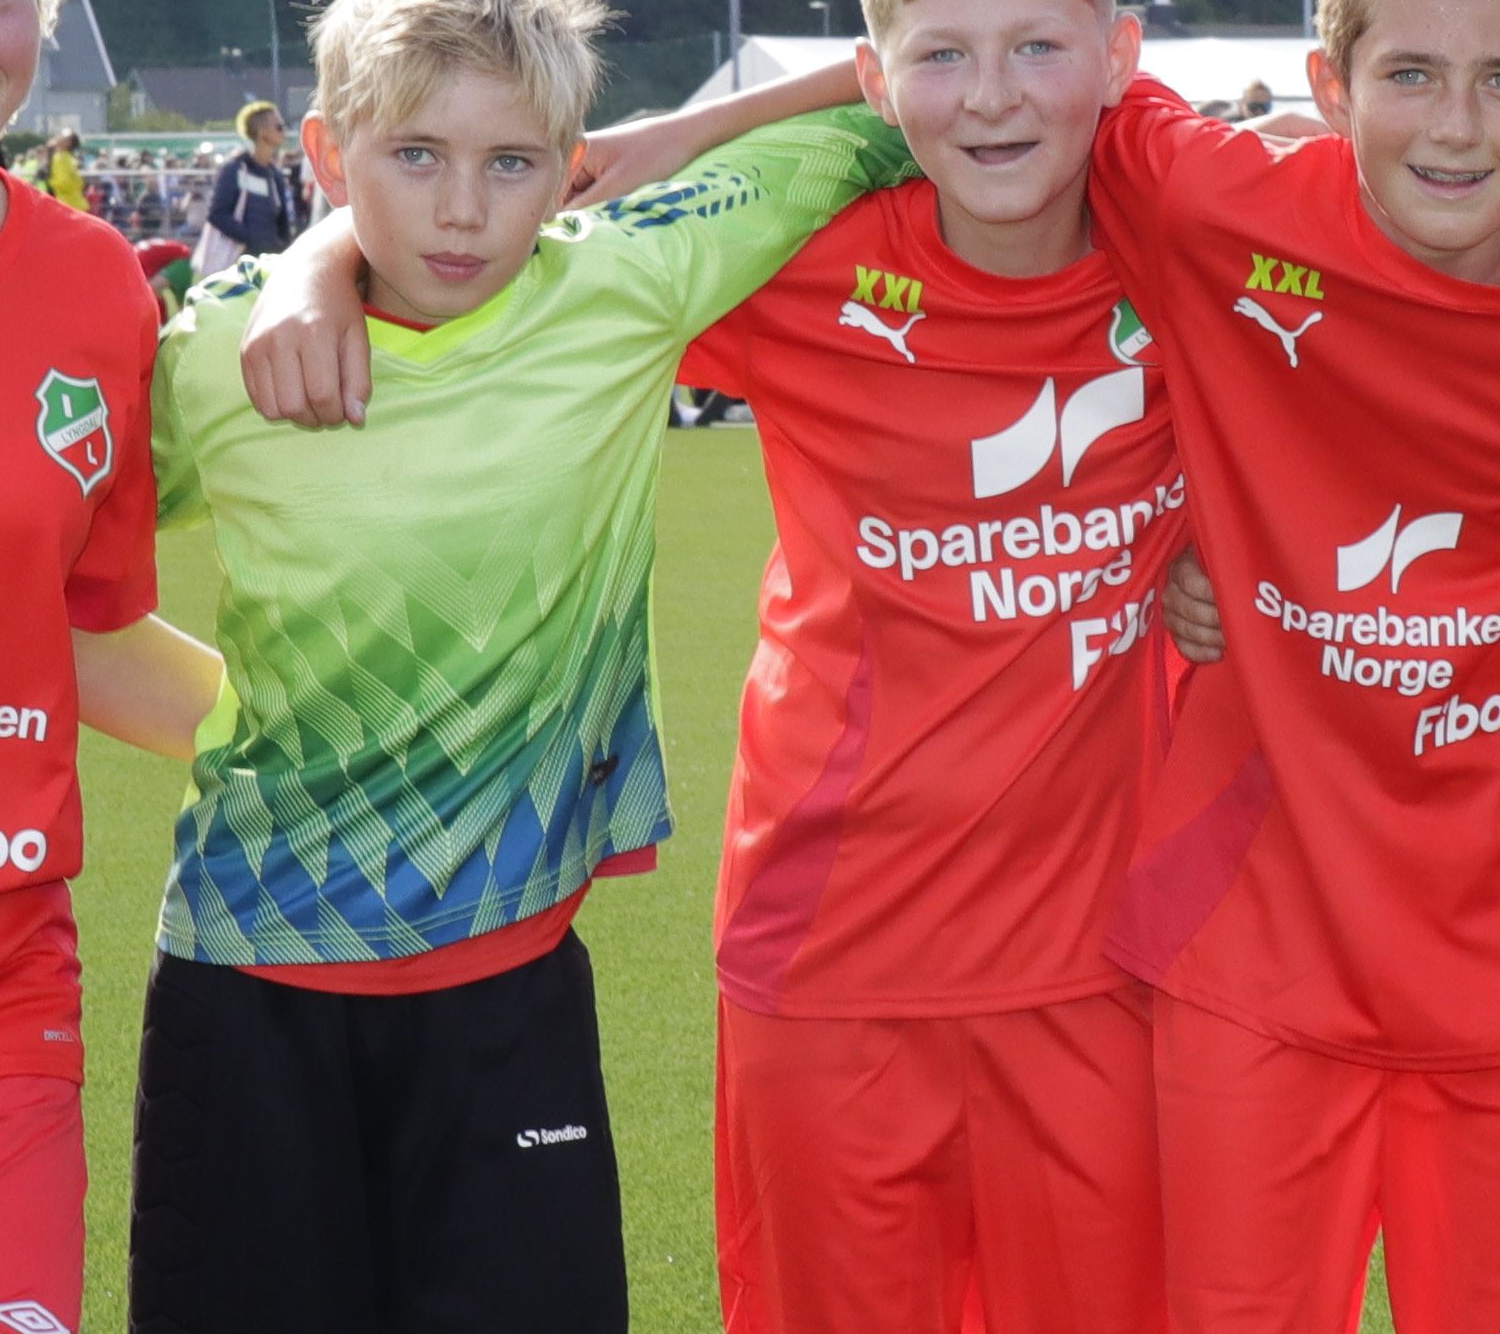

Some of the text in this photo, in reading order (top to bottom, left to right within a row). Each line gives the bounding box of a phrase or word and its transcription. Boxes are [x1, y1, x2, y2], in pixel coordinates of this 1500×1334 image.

[853, 264, 924, 314] XXL
[1245, 252, 1325, 301] XXL
[856, 472, 1187, 581] Spareban
[1320, 645, 1453, 697] Norge
[541, 1124, 587, 1145] Sondico
